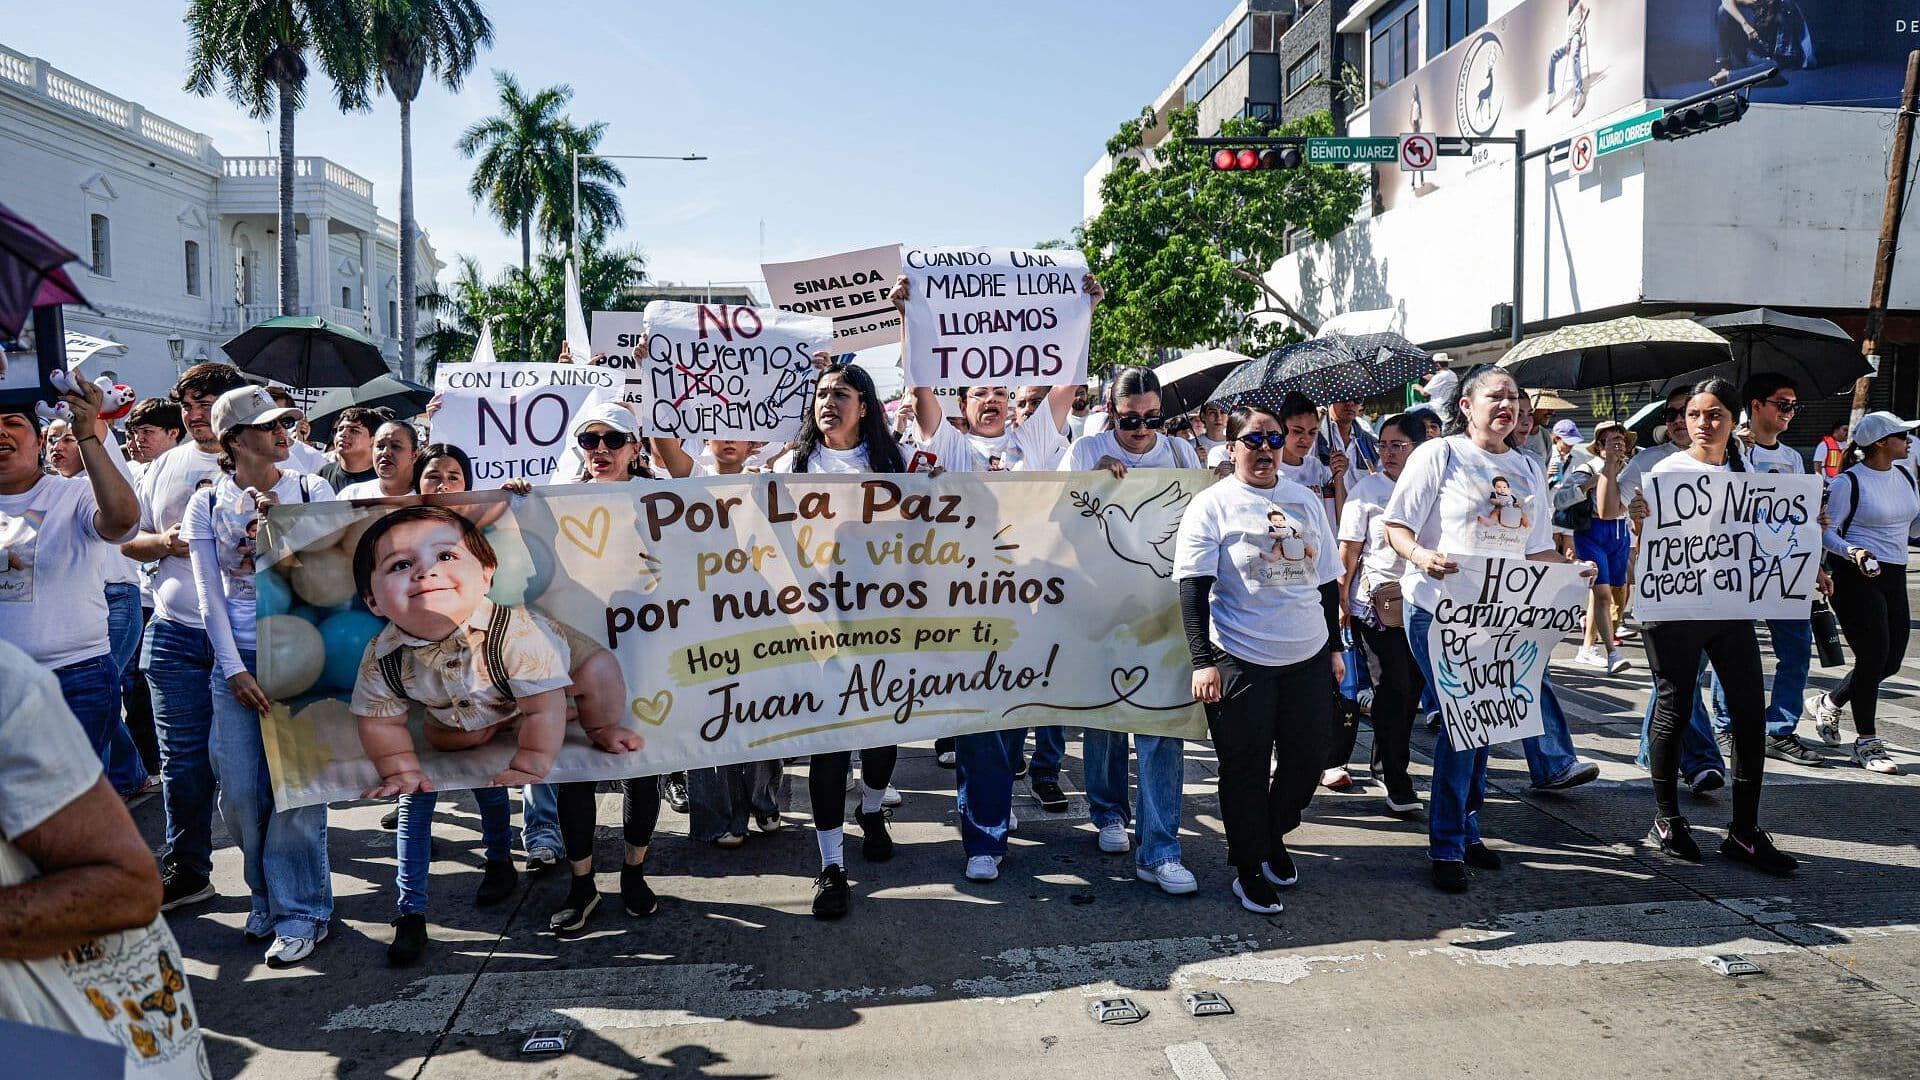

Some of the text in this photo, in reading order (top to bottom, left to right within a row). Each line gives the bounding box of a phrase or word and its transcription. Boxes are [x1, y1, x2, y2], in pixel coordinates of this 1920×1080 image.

[1311, 145, 1395, 159] BENITO JUAREZ
[1598, 120, 1652, 151] ALVARO OBREG
[906, 250, 1057, 269] CUANDO UNA
[794, 270, 884, 295] SINALOA
[848, 290, 877, 306] DE
[926, 272, 1076, 299] MADRE LLORA
[697, 304, 762, 342] NO
[841, 327, 858, 337] DE
[860, 323, 877, 333] LO
[939, 307, 1058, 336] LLORAMOS
[501, 370, 539, 389] LOS
[931, 344, 1063, 379] TODAS
[477, 392, 570, 447] NO
[640, 480, 976, 542] Por La Paz,
[1652, 474, 1712, 529] LOS
[697, 525, 976, 592] por la vida,
[1647, 531, 1757, 571] merecen
[1640, 552, 1812, 603] crecer en PAZ
[605, 570, 1065, 649] por nuestros niños
[686, 620, 999, 675] Hoy caminamos por ti,
[699, 643, 1060, 742] Juan Alejandro!
[1458, 656, 1515, 696] Juan
[1445, 687, 1528, 750] Alejandro
